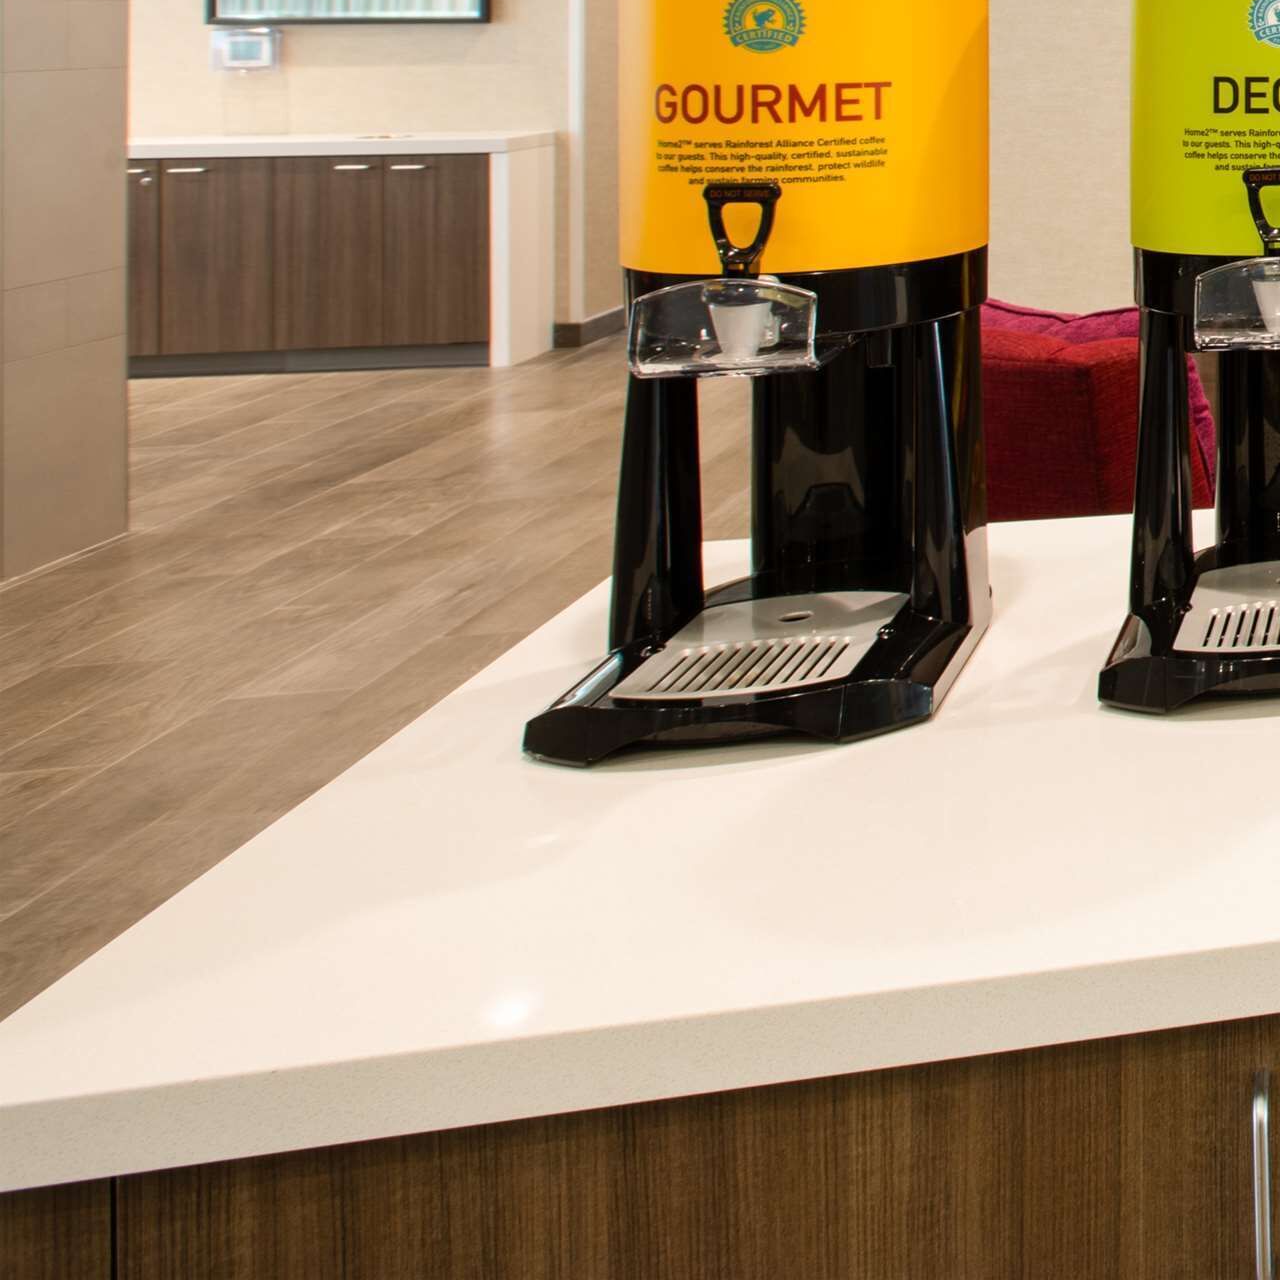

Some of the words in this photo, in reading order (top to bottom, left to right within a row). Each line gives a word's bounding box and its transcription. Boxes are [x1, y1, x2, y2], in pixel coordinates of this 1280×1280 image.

[736, 29, 793, 44] CERTIFIED
[655, 81, 892, 125] GOURMET
[694, 141, 722, 149] serves
[725, 139, 773, 148] Rainforest
[776, 139, 815, 148] Alliance
[817, 137, 857, 147] Certified
[859, 136, 886, 145] coffee
[1234, 140, 1252, 148] This
[710, 152, 728, 161] This
[836, 148, 888, 158] sustainable
[1184, 151, 1205, 160] coffee
[1207, 152, 1228, 160] helps
[680, 165, 703, 174] helps
[748, 164, 763, 172] the
[818, 161, 852, 172] protect
[853, 160, 886, 169] wildlife
[1215, 163, 1229, 171] and
[689, 177, 704, 185] and
[781, 174, 847, 185] communities.
